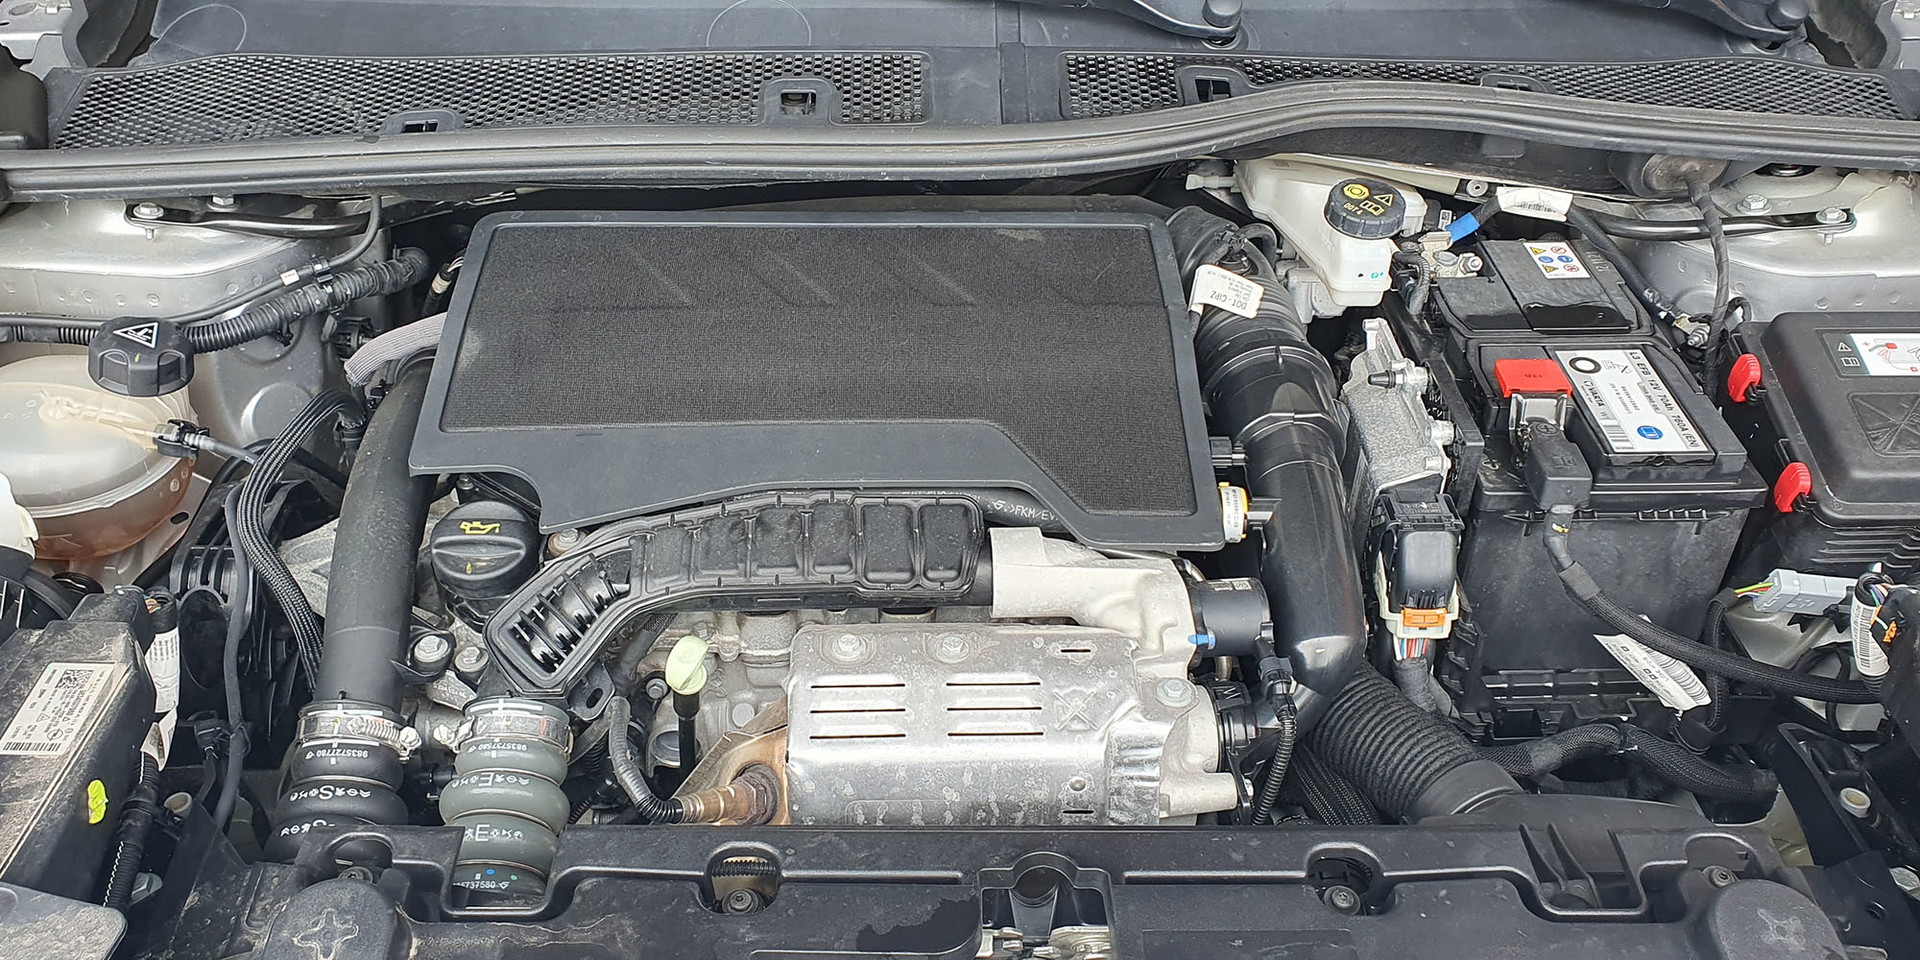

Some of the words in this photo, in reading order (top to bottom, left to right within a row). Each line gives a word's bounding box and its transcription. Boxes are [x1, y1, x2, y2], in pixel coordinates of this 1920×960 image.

[1231, 299, 1248, 310] DOT
[1588, 385, 1606, 408] VARTA
[1629, 351, 1641, 360] L3
[1636, 362, 1652, 376] EFB
[1647, 379, 1662, 391] 12V
[1657, 394, 1675, 411] 70Ah
[1671, 414, 1690, 432] 760A
[1681, 433, 1701, 448] (EN)
[316, 748, 369, 759] 9835727780
